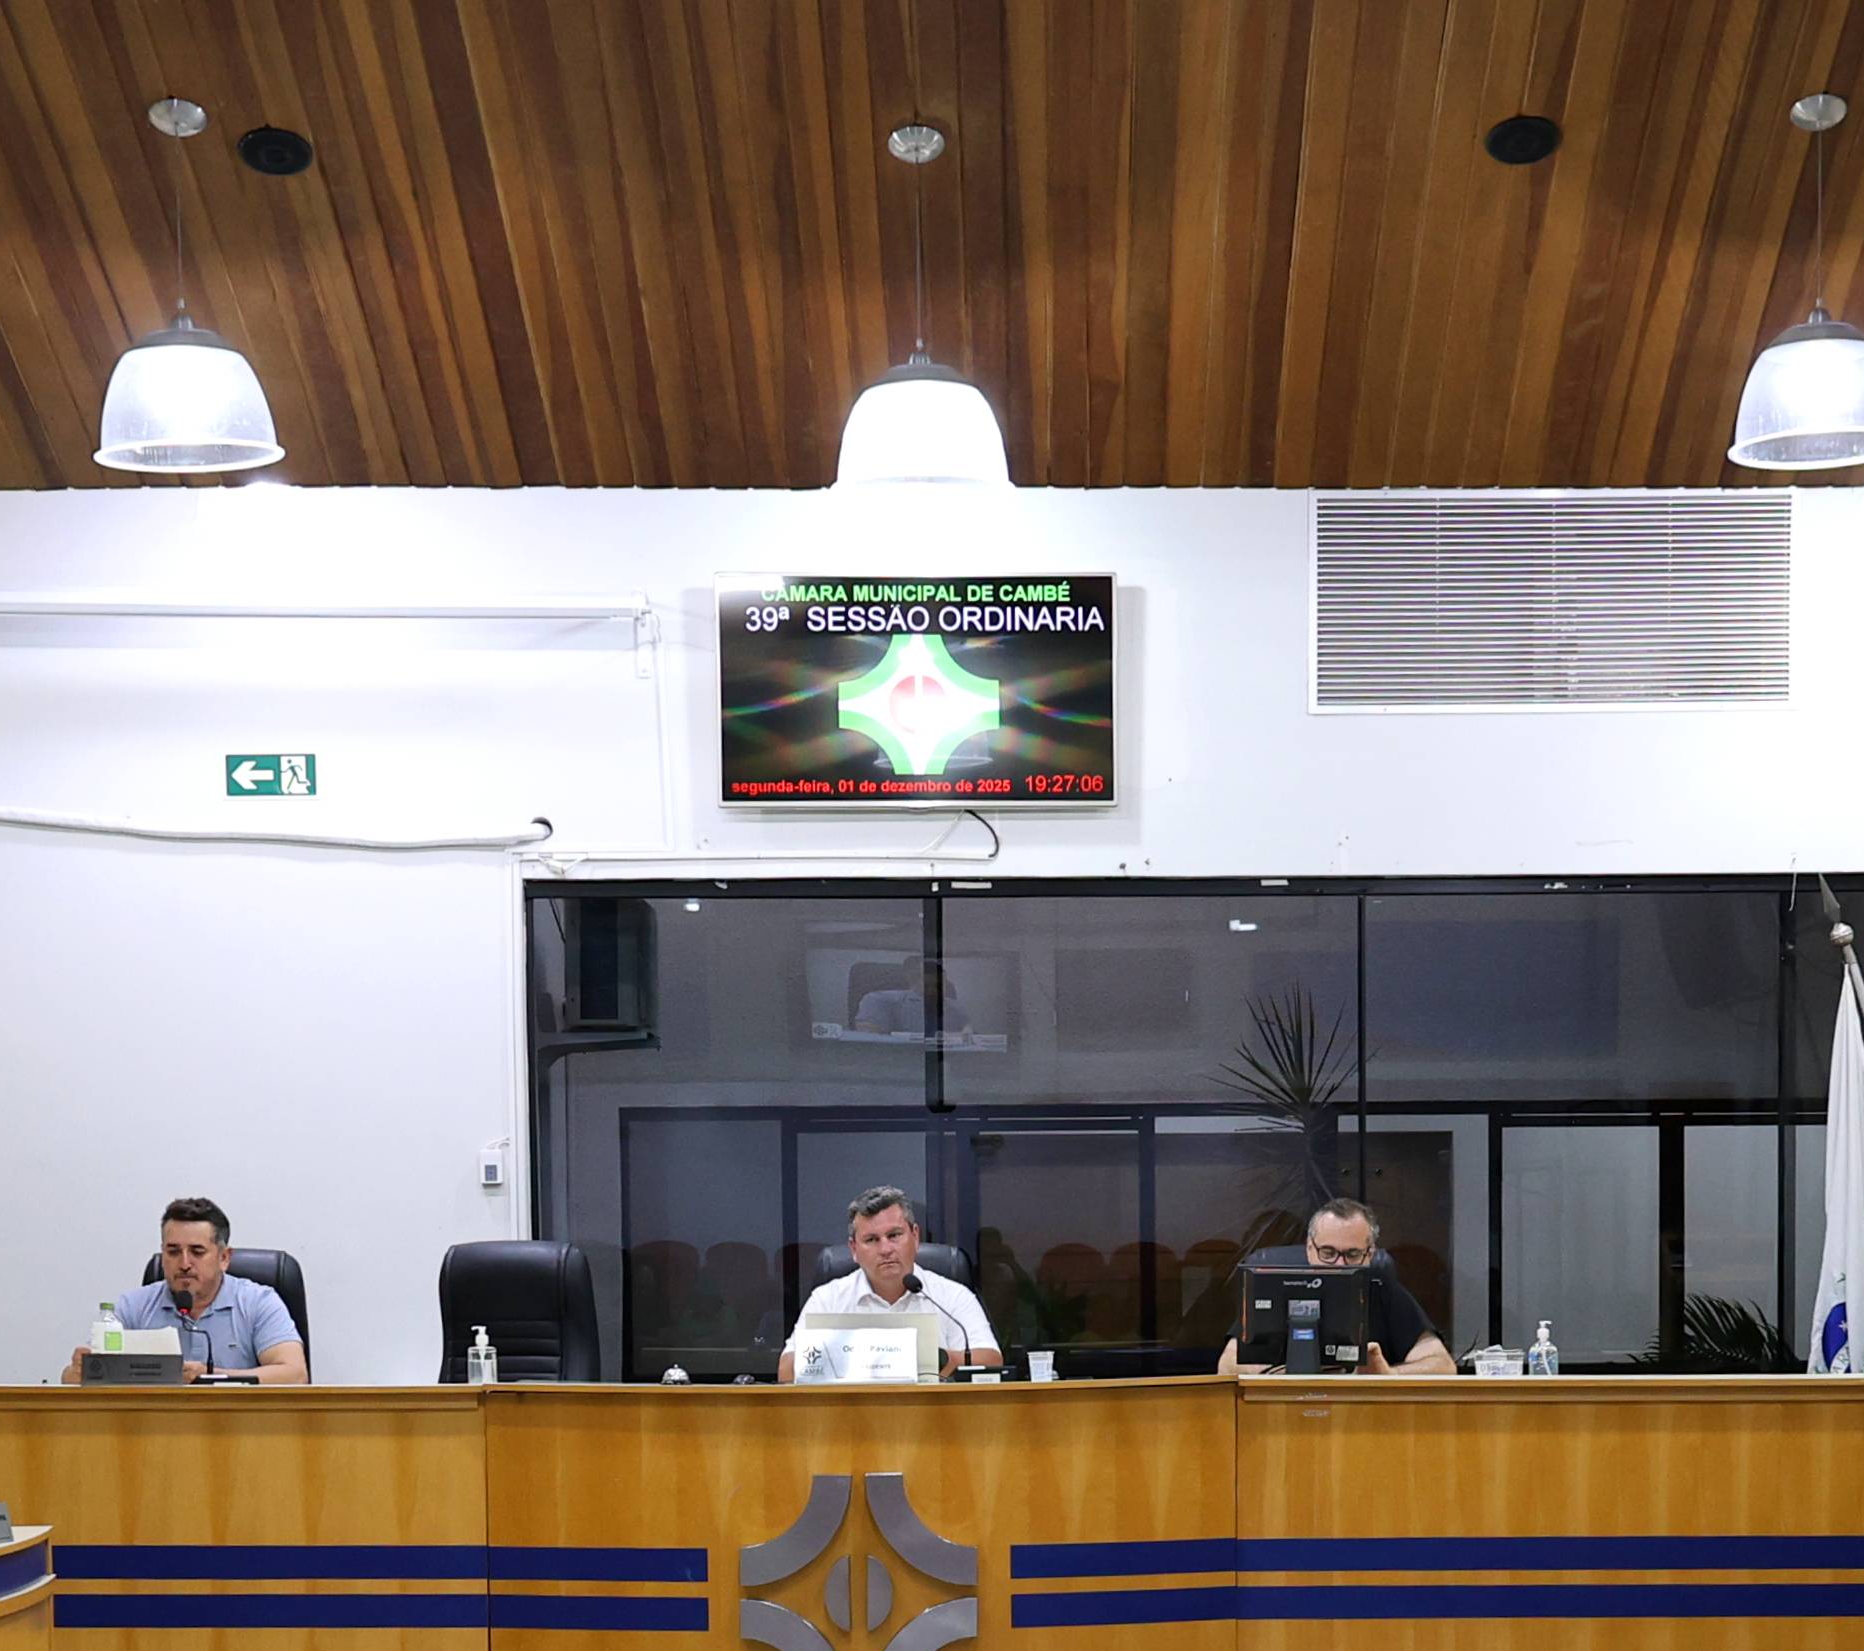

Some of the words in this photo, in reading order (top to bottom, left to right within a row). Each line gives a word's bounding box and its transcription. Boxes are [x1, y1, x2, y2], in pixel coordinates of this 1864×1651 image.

[853, 585, 961, 601] MUNICIPAL
[967, 585, 994, 601] DE
[999, 581, 1071, 602] CAMBÉ
[806, 604, 931, 632] SESSÃO
[938, 606, 1105, 632] ORDINARIA
[732, 779, 835, 796] segunda-feira,
[838, 779, 854, 793] 01
[859, 779, 877, 793] de
[881, 779, 952, 793] dezembro
[955, 779, 974, 793] de
[977, 779, 1012, 793] 2025
[1024, 775, 1104, 794] 19:27:06
